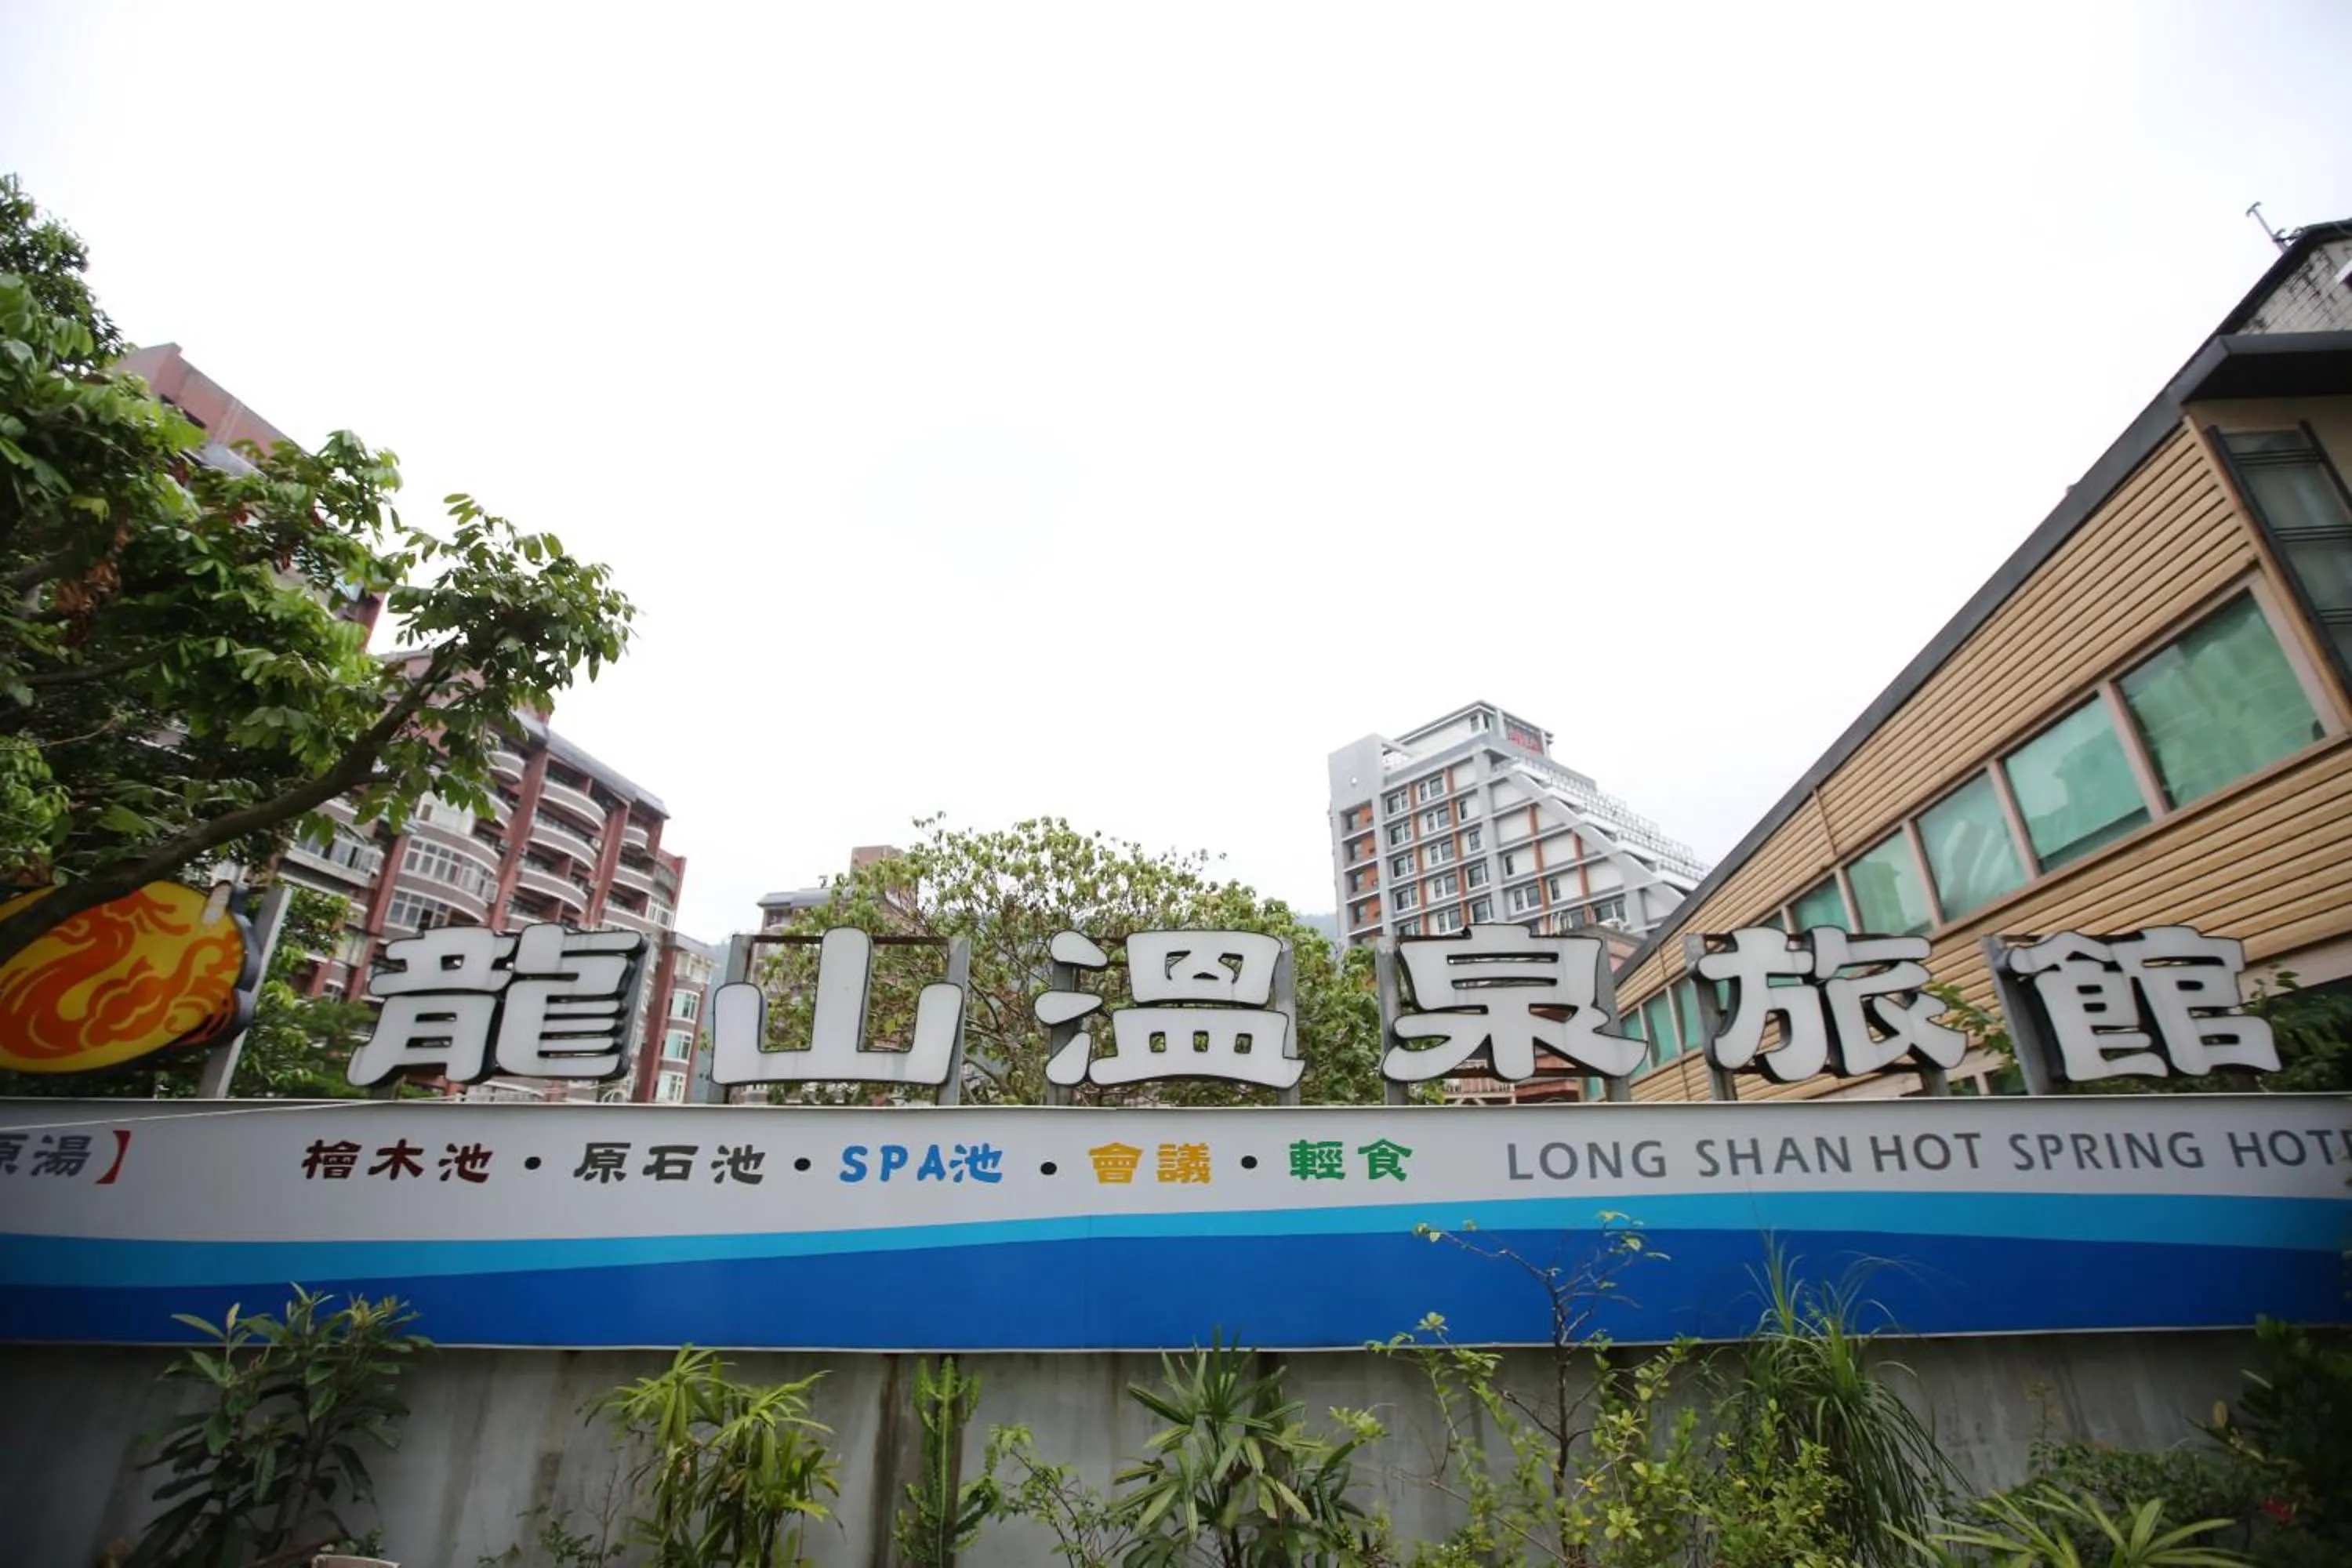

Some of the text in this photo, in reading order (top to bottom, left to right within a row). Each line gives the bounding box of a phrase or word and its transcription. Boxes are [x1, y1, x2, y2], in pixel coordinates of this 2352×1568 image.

[347, 924, 2283, 1087] 龍山溫泉旅館
[301, 1138, 1413, 1185] 檜木池 原石池 SPA池 會議 輕食
[1508, 1141, 1667, 1180] LONG
[1697, 1137, 1853, 1177] SHAN
[1871, 1133, 1982, 1171] HOT
[2009, 1131, 2205, 1170] SPRING
